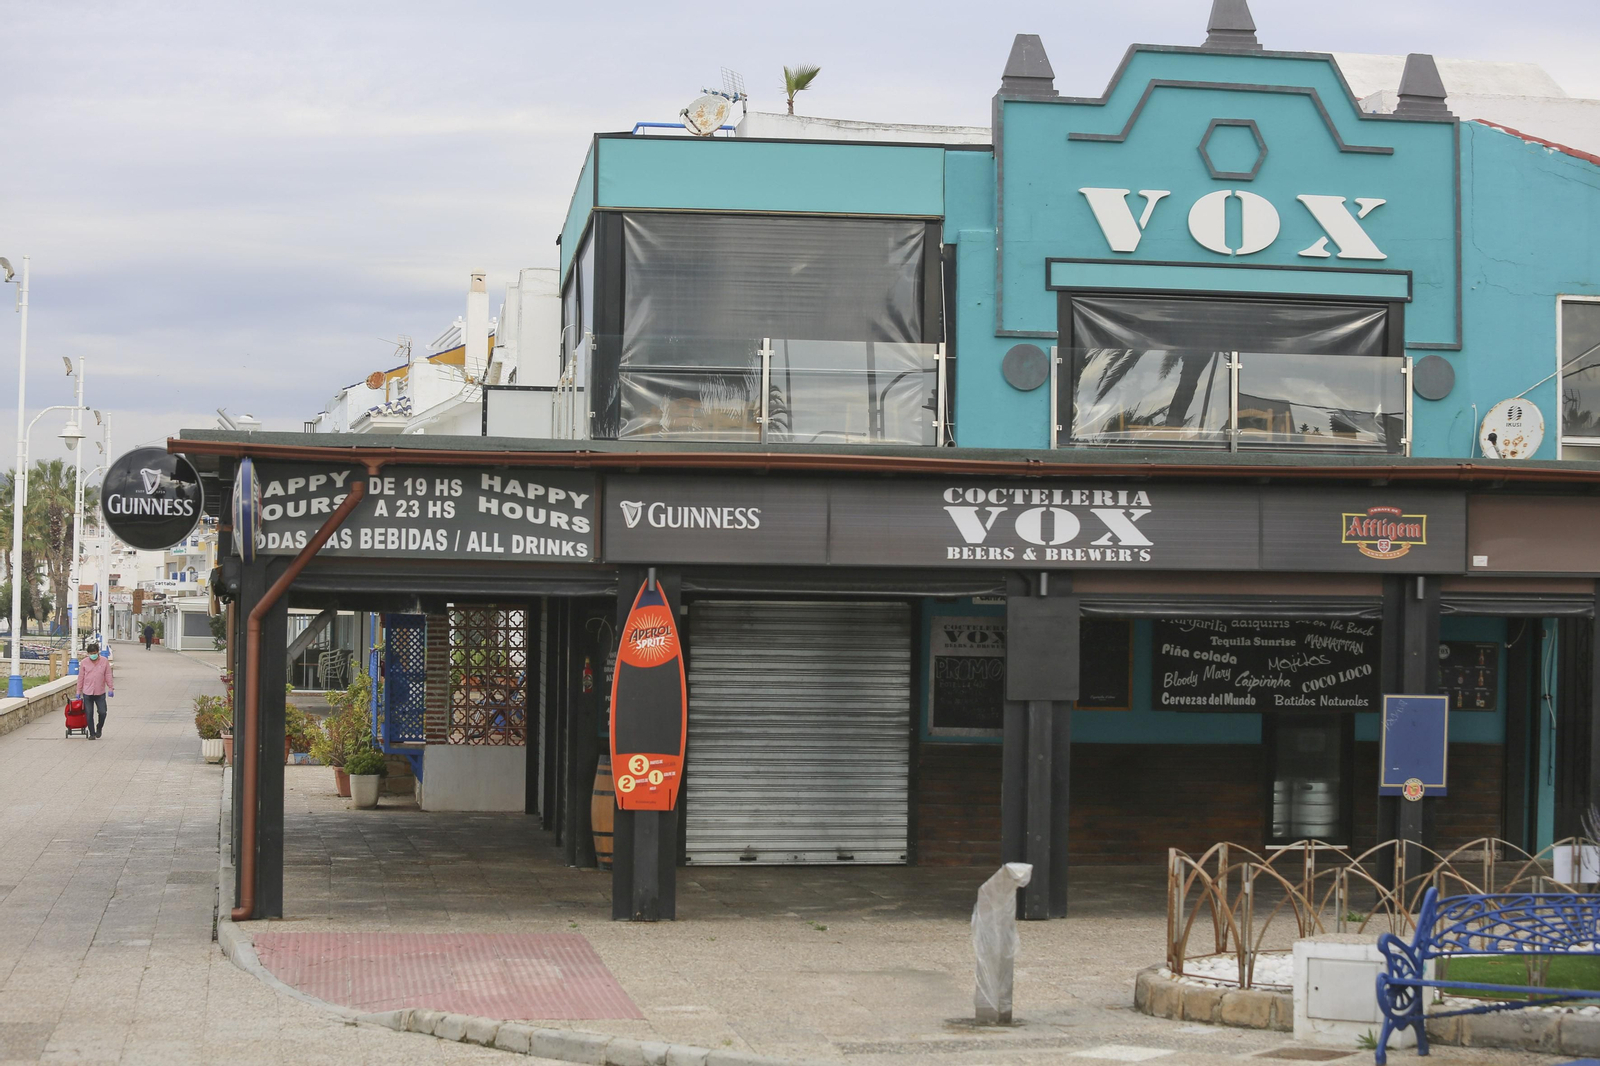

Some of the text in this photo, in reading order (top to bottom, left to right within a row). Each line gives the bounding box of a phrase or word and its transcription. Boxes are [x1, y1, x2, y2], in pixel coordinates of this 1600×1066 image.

[1078, 187, 1387, 260] VOX
[263, 470, 350, 498] APPY
[369, 477, 462, 496] DE 19 HS
[481, 473, 589, 509] HAPPY
[108, 494, 194, 516] GUINNESS
[943, 487, 1152, 506] COCTELERIA
[374, 500, 455, 518] A 23 HS
[478, 496, 590, 534] HOURS
[648, 502, 760, 529] GUINNESS
[943, 506, 1154, 546] VOX
[1346, 516, 1422, 541] Affligem
[257, 531, 306, 549] ODAS
[360, 528, 447, 551] BEBIDAS
[466, 531, 504, 553] ALL
[512, 534, 588, 557] DRINKS
[947, 546, 1151, 562] BEERS & BREWER'S
[629, 625, 672, 643] APEROL
[1346, 622, 1374, 636] Beach
[636, 636, 666, 650] SPRITZ
[1210, 636, 1296, 647] Tequila Sunrise
[1162, 644, 1238, 664] Piña colada
[1268, 652, 1332, 672] Mojitos
[1164, 664, 1231, 688] Bloody Mary
[1234, 670, 1291, 692] Caipirinha
[1302, 664, 1372, 692] COCO LOCO
[1162, 692, 1256, 706] Cervezas del Mundo
[1274, 694, 1369, 706] Batidos Naturales
[634, 758, 644, 772] 3
[622, 778, 630, 789] 2
[654, 772, 658, 782] 1
